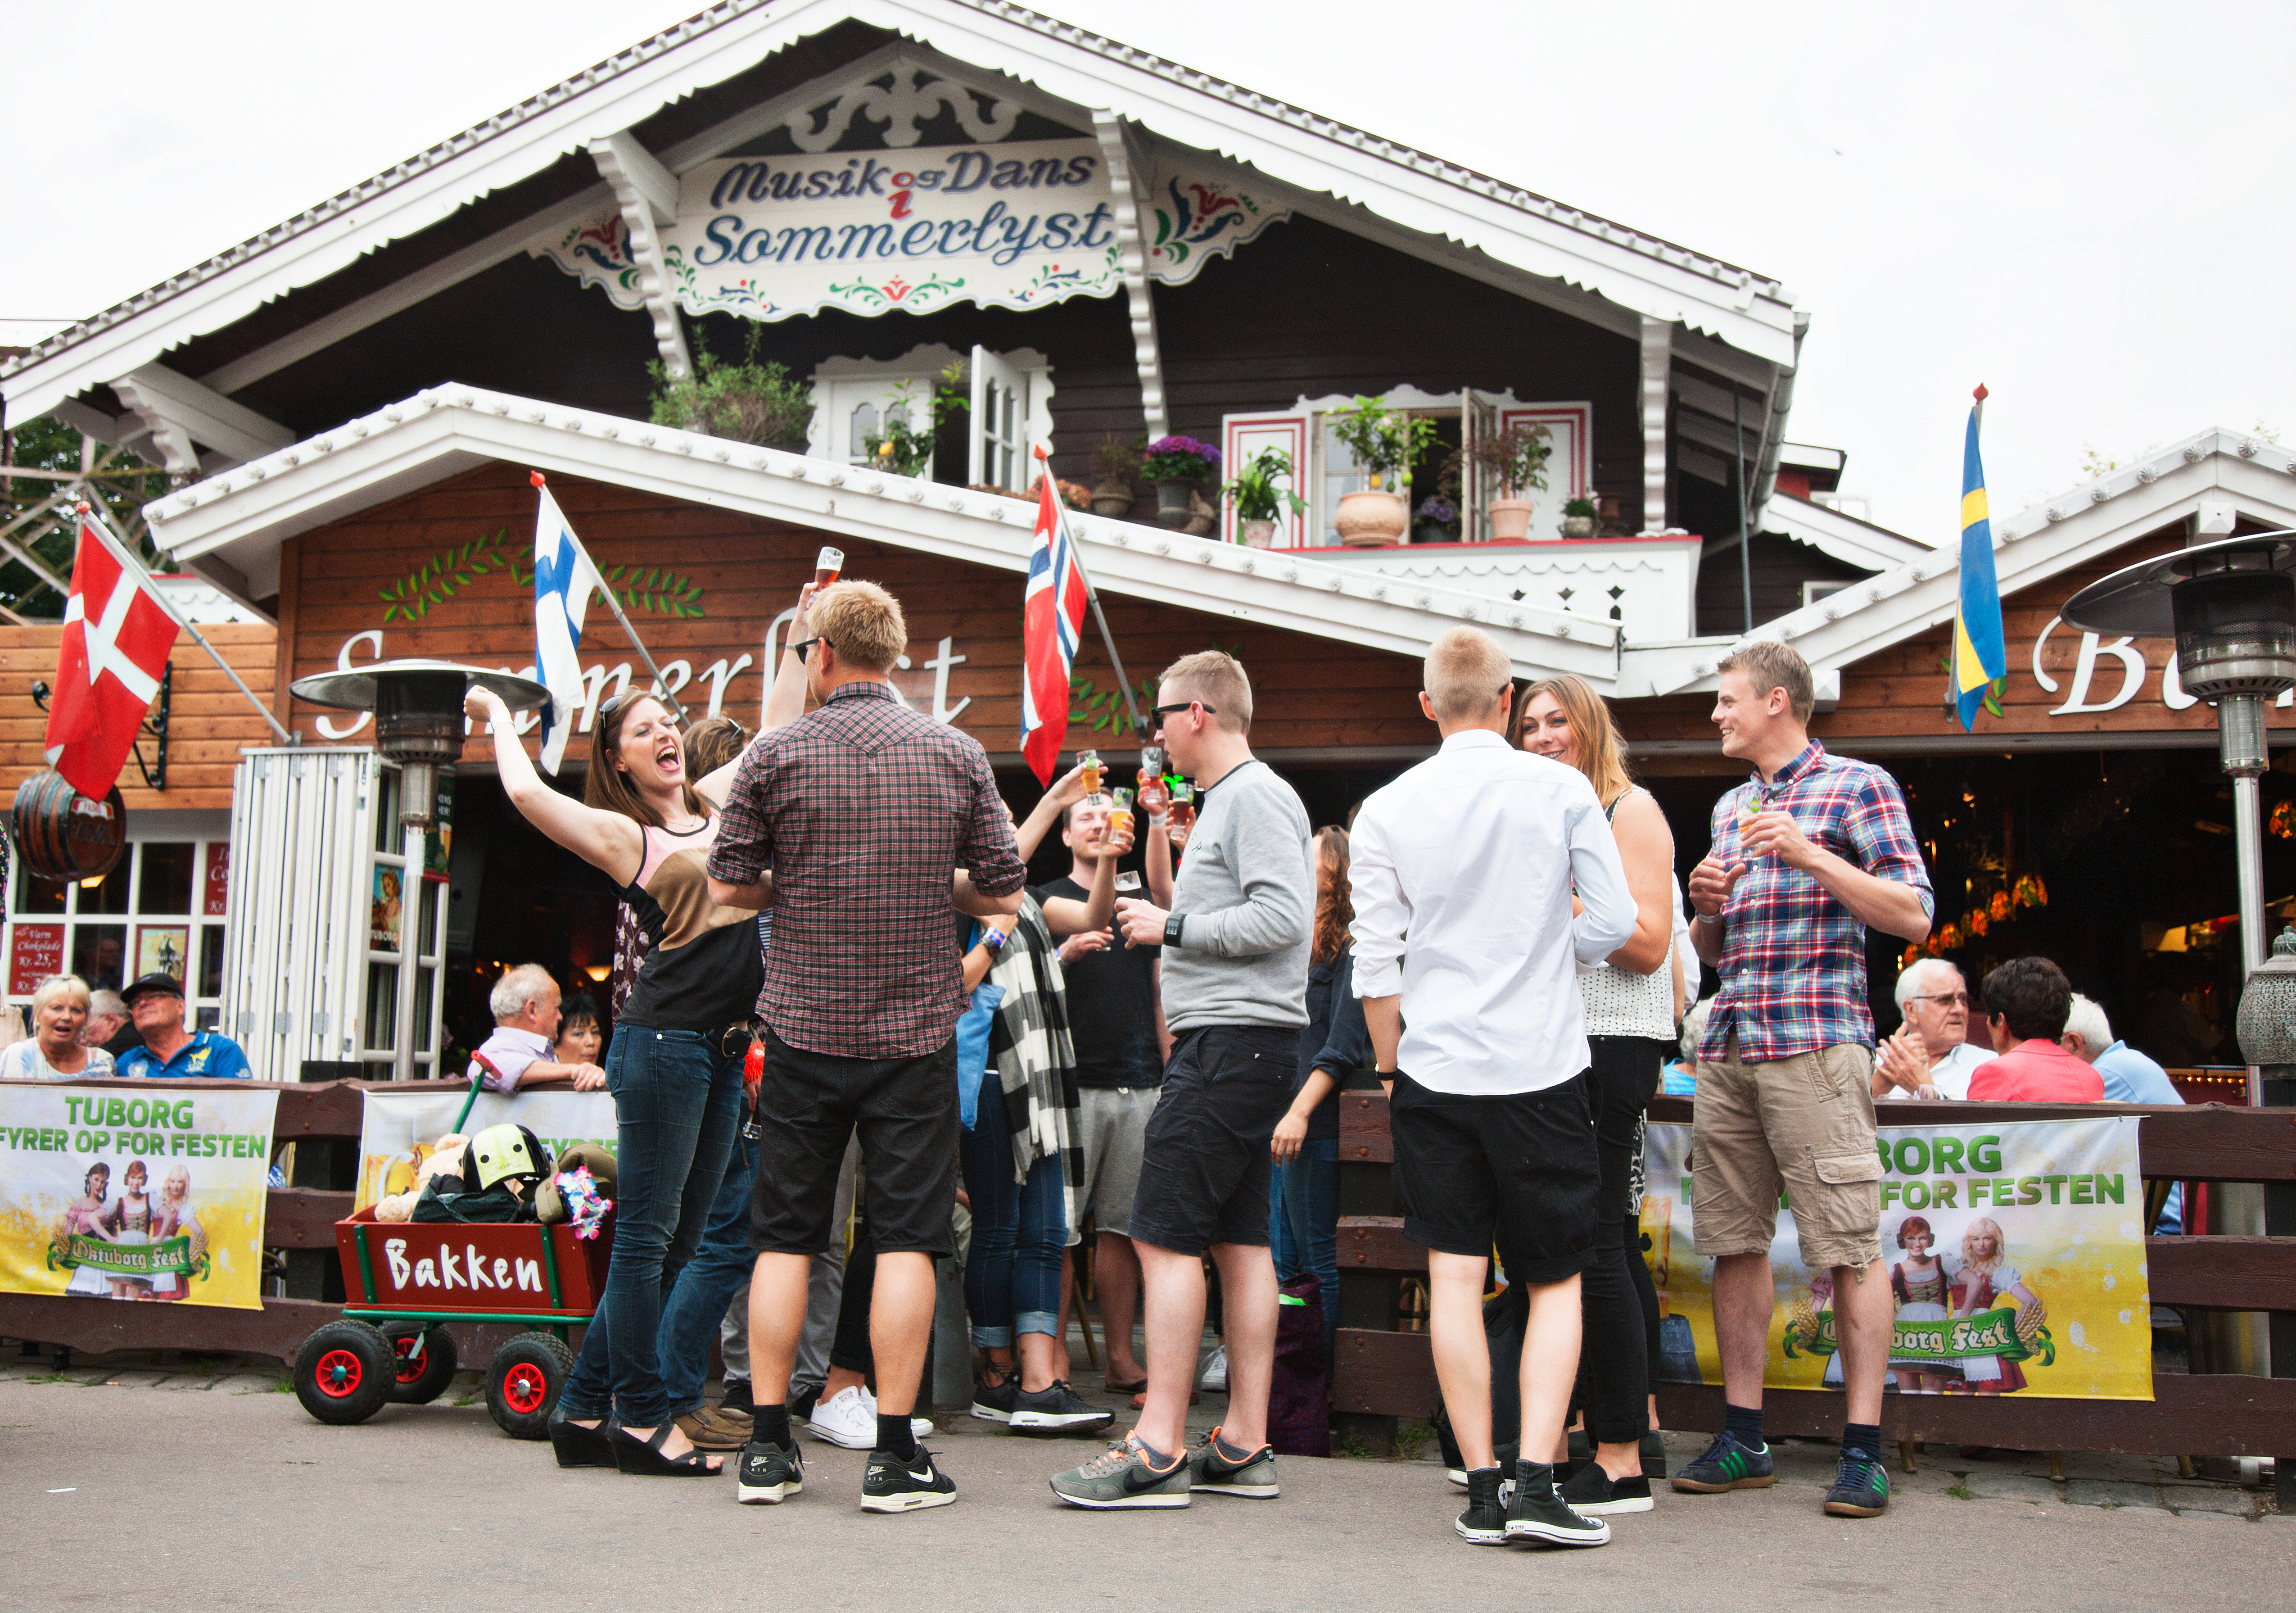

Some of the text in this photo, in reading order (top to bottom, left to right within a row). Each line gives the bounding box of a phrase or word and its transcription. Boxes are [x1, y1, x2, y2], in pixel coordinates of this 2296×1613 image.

[710, 158, 892, 210] Musik
[942, 151, 1098, 195] Dans
[695, 200, 1114, 267] Sommerlyst
[64, 1096, 194, 1129] TUBORG
[75, 1130, 110, 1154] OP
[116, 1131, 165, 1155] FOR
[170, 1133, 266, 1158] FESTEN
[1879, 1174, 2125, 1210] FOR FESTEN
[72, 1239, 185, 1270] Oktuborg Fest
[384, 1238, 543, 1293] Bakken
[1950, 1317, 2012, 1352] Fest
